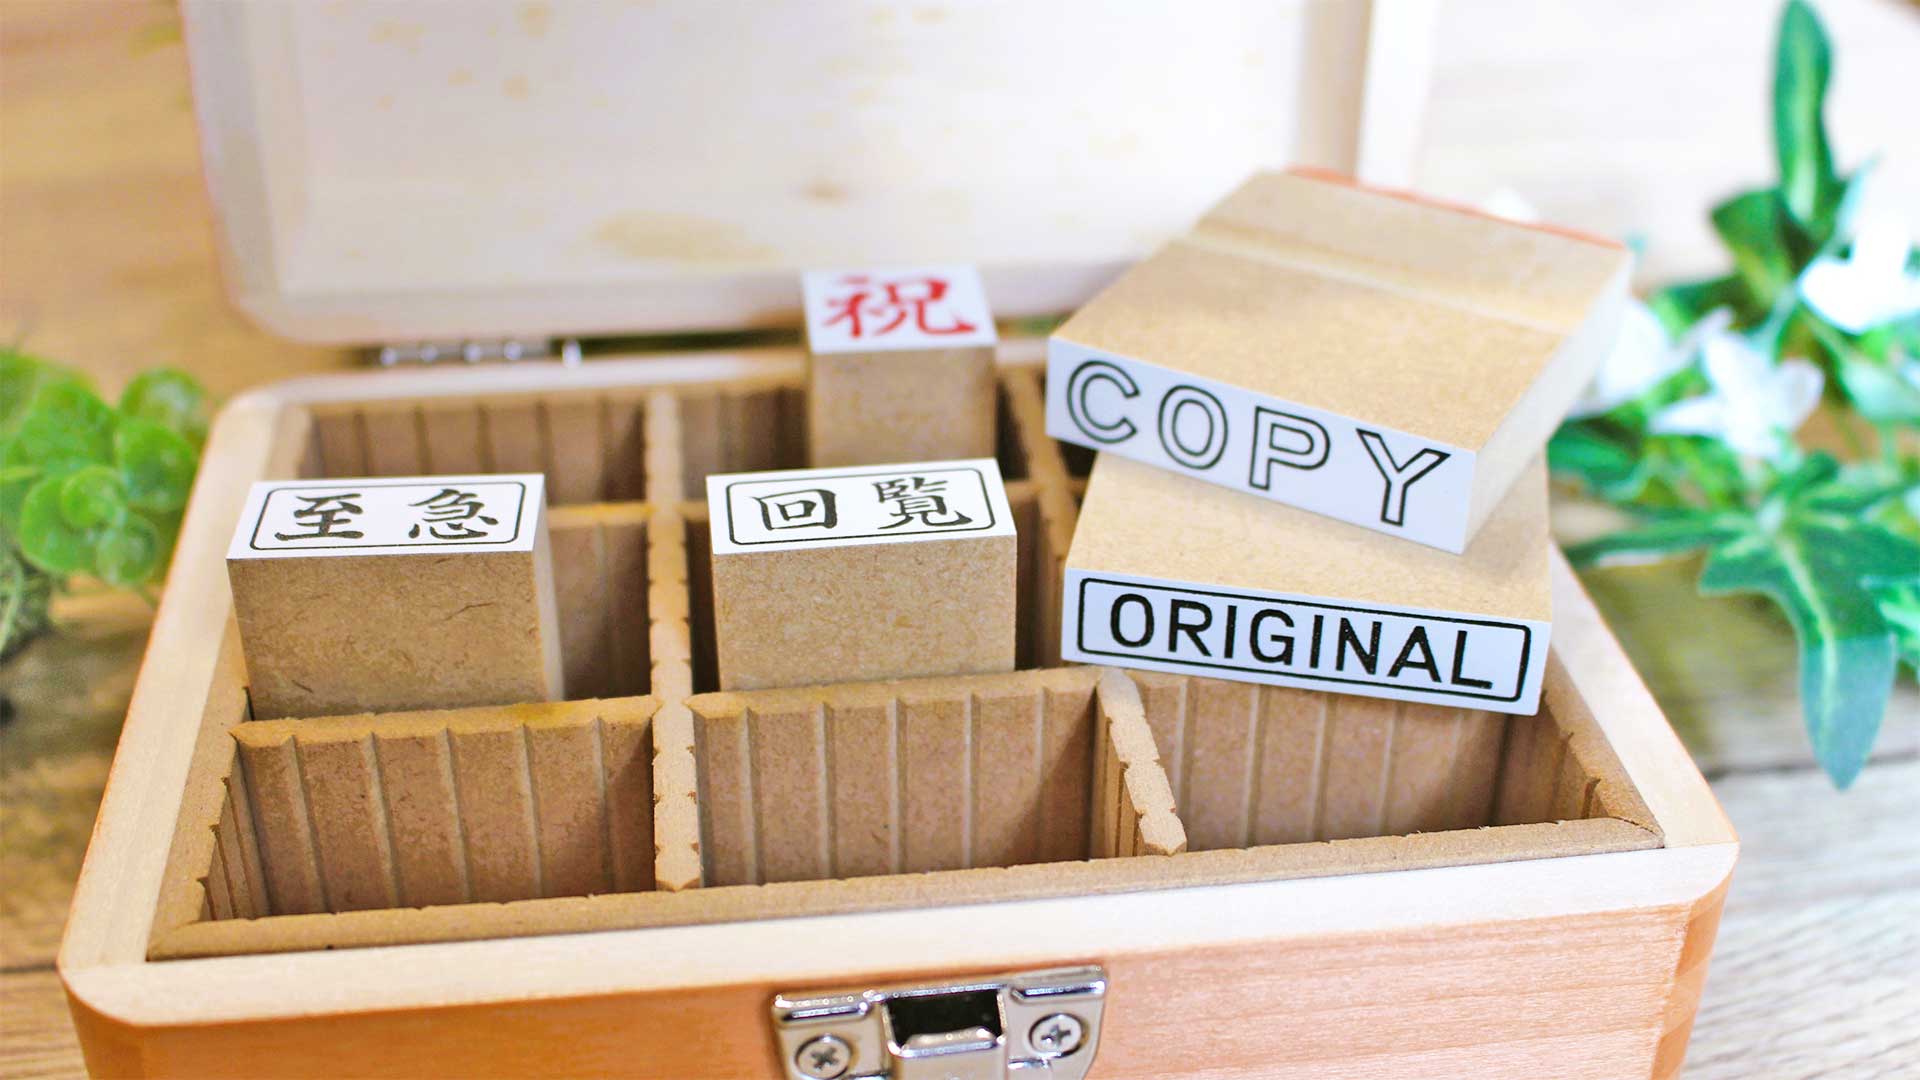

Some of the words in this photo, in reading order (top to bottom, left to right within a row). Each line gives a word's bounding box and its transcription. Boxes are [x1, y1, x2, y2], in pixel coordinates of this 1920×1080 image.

[822, 275, 978, 338] 祝
[1066, 360, 1450, 527] COPY
[274, 487, 499, 542] 至急
[752, 475, 973, 531] 回覧
[1109, 592, 1493, 690] ORIGINAL
